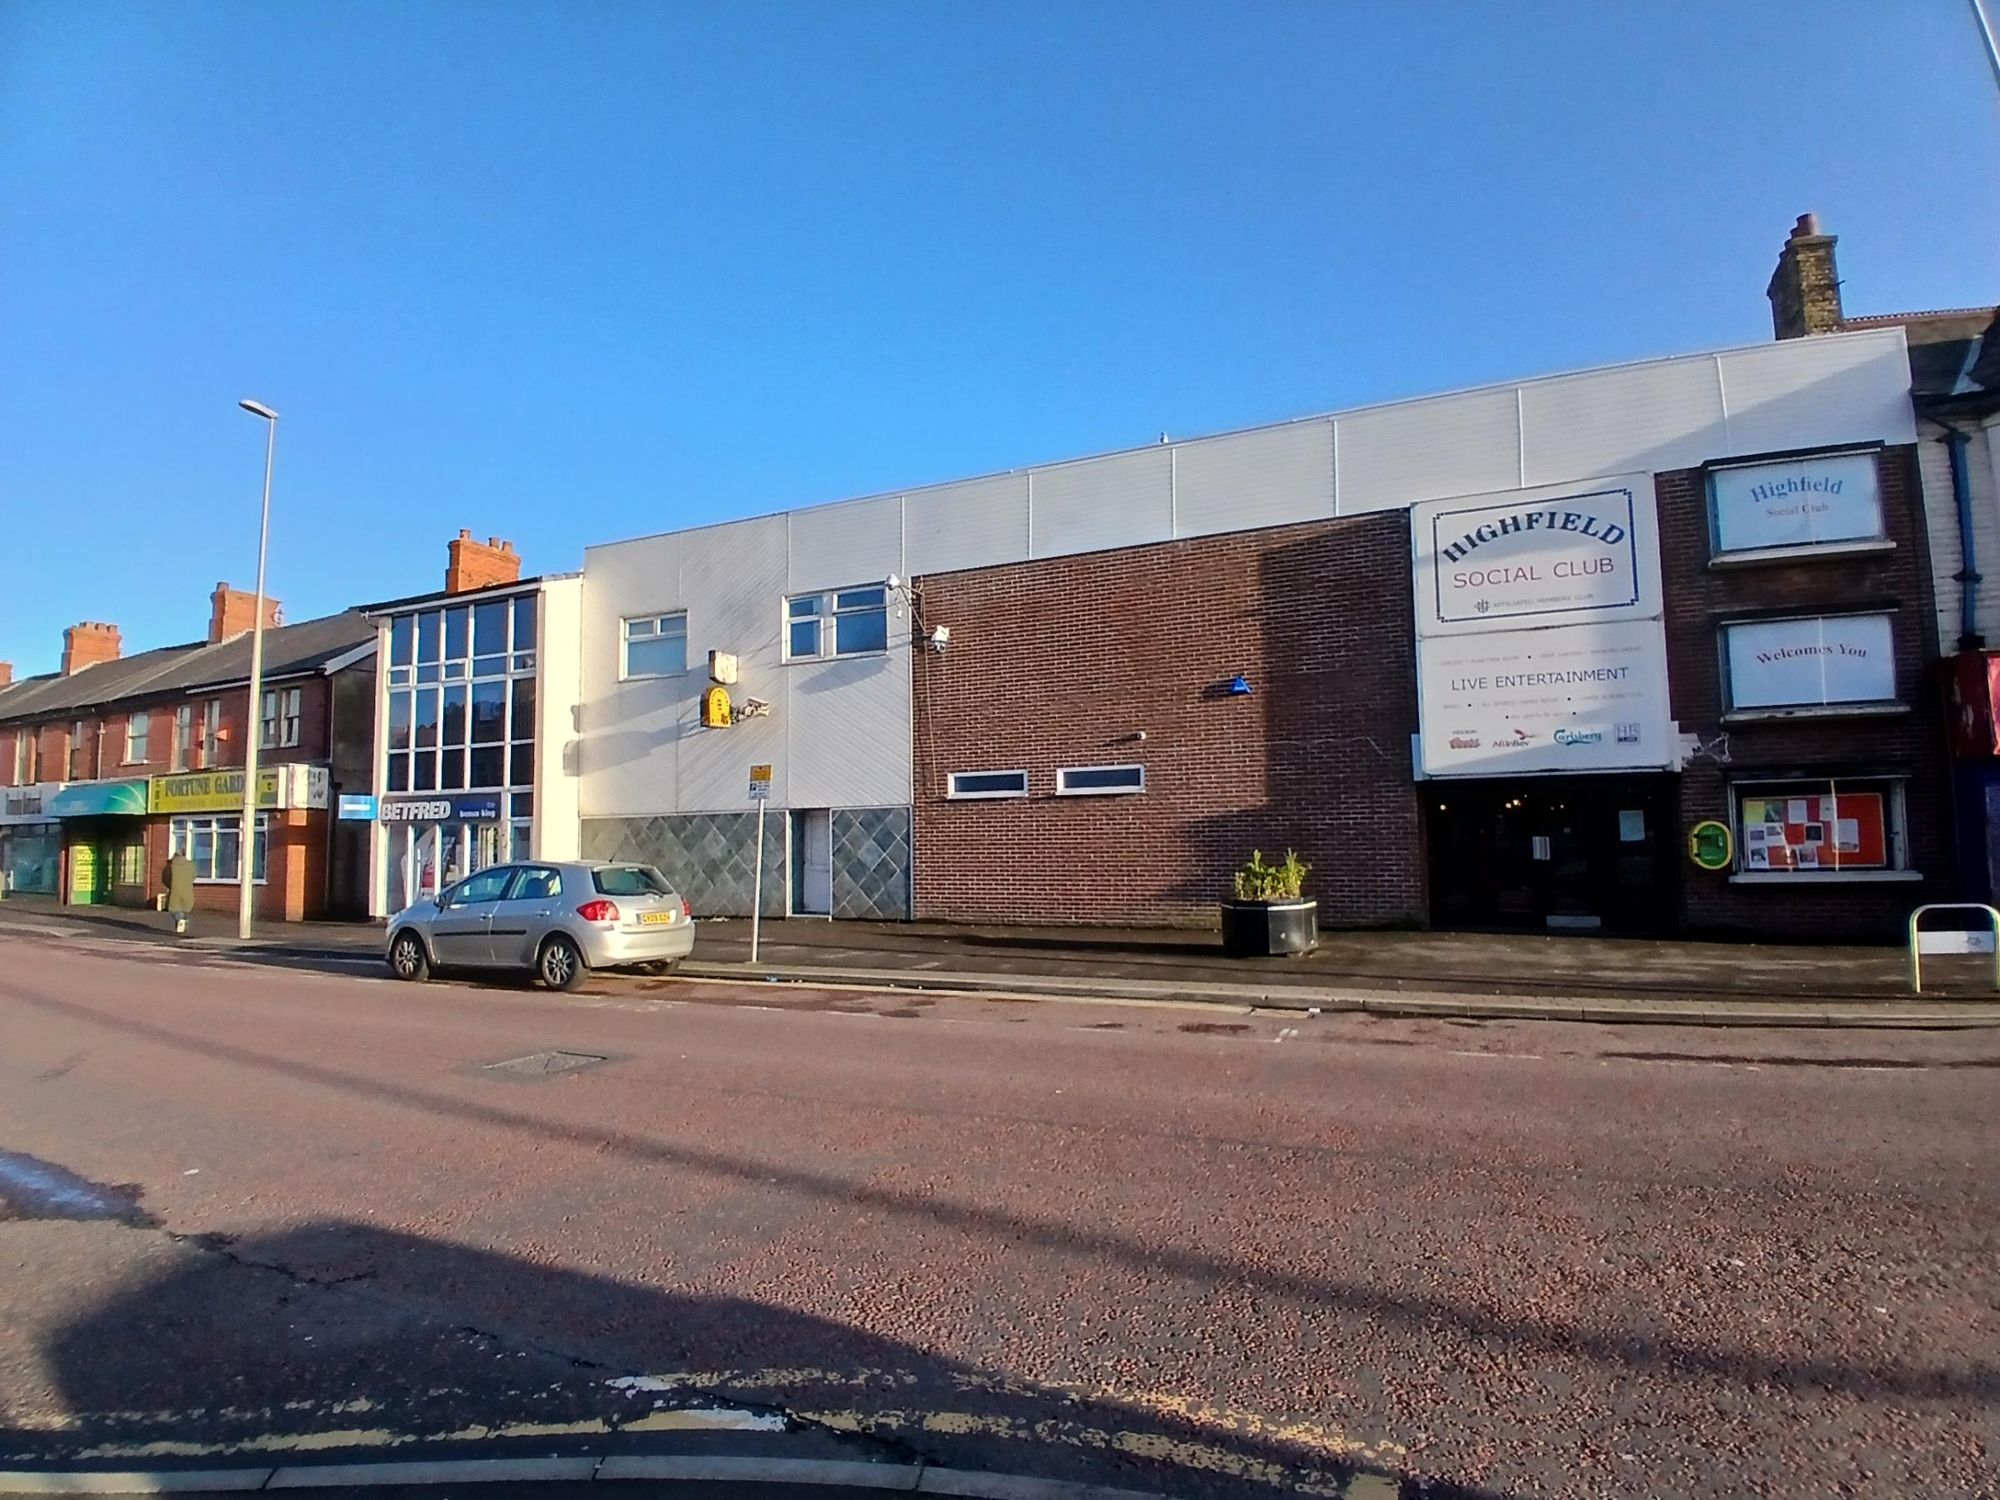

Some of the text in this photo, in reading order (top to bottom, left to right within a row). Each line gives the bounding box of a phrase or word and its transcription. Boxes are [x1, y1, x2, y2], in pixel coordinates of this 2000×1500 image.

[1750, 476, 1843, 503] Highfield
[1766, 502, 1830, 518] Social Club
[1442, 511, 1625, 563] HIGHFIELD
[1453, 557, 1615, 589] SOCIAL CLUB
[1757, 643, 1868, 665] Welcomes You
[1451, 666, 1629, 691] LIVE ENTERTAINMENT
[1554, 728, 1602, 745] Carlsberg
[165, 777, 210, 797] FORTUNE
[381, 801, 452, 821] BETFRED
